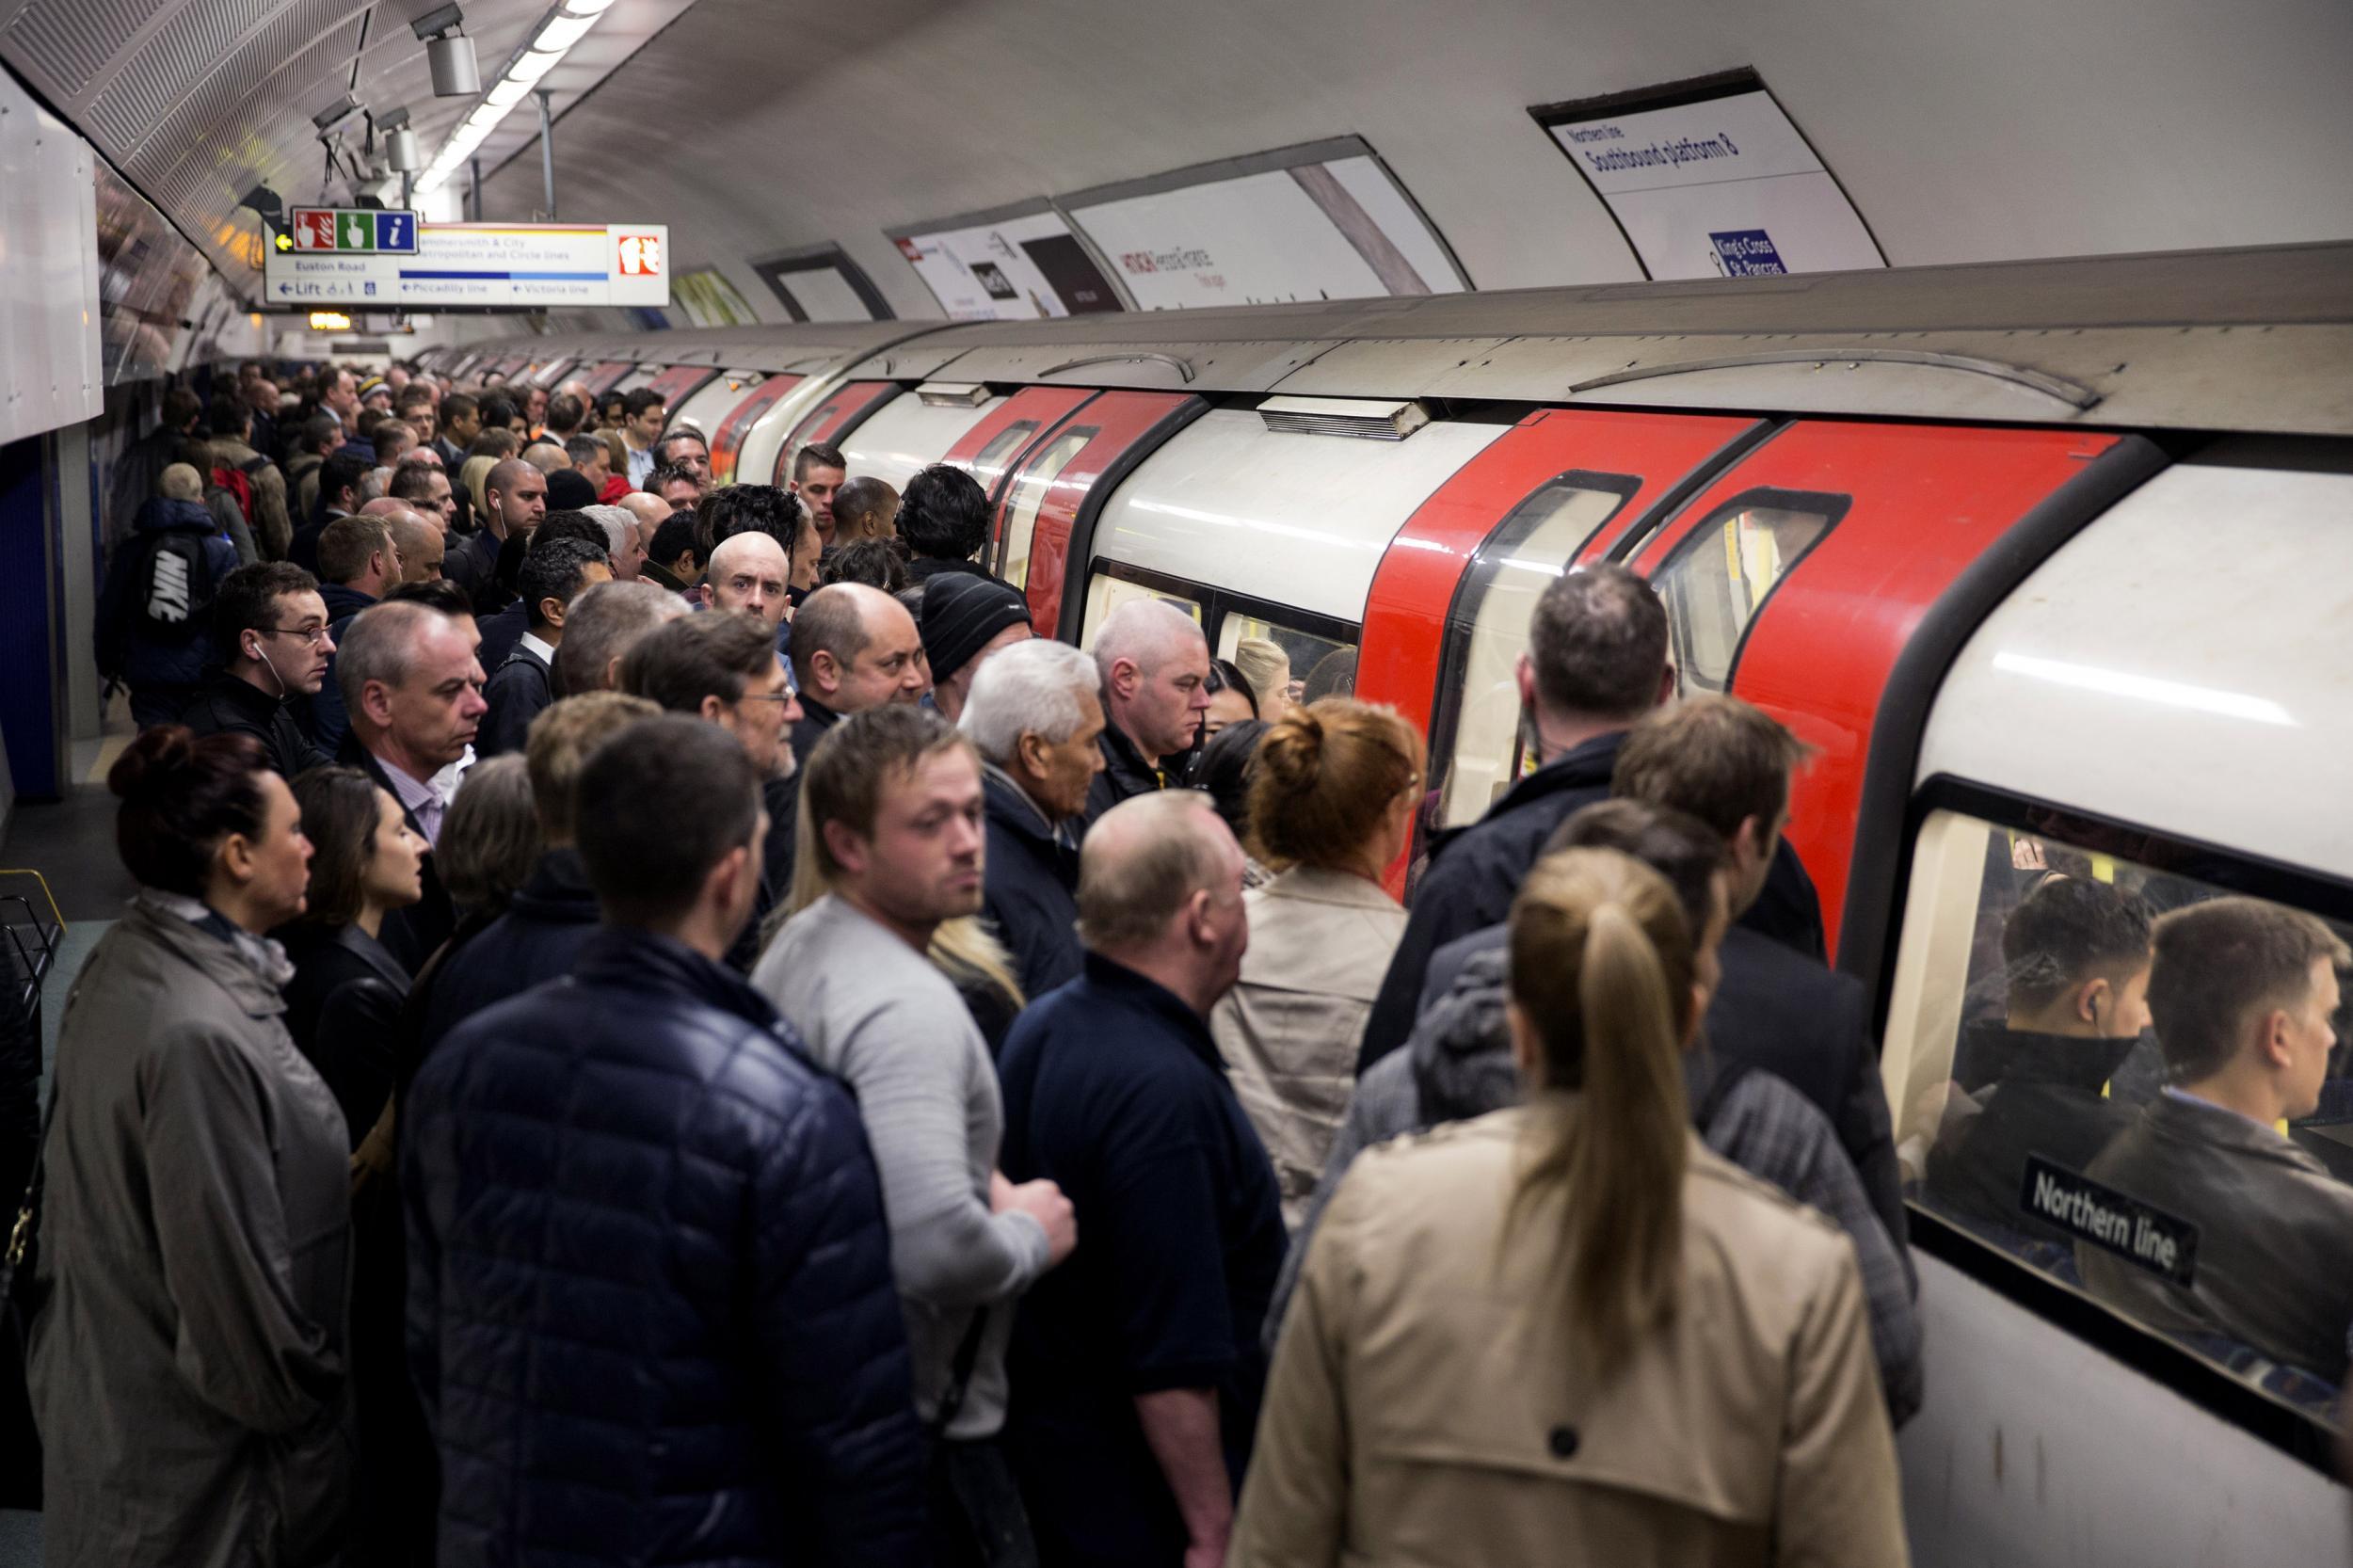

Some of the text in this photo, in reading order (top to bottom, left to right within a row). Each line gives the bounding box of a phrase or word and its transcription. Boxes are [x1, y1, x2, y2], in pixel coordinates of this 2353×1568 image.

[1566, 125, 1625, 143] Northern line
[1585, 132, 1739, 171] Southbound platform 8
[420, 237, 489, 247] ammersmith
[504, 237, 526, 248] City
[1714, 237, 1773, 260] King's Cross
[487, 248, 507, 260] and
[509, 249, 541, 261] Circle
[544, 249, 570, 261] lines
[295, 261, 366, 272] Euston Road
[295, 282, 321, 296] Lift
[412, 283, 488, 295] Piccadilly line
[524, 284, 589, 295] Victoria line
[148, 549, 188, 622] NIKE
[2033, 1171, 2177, 1270] Northern line
